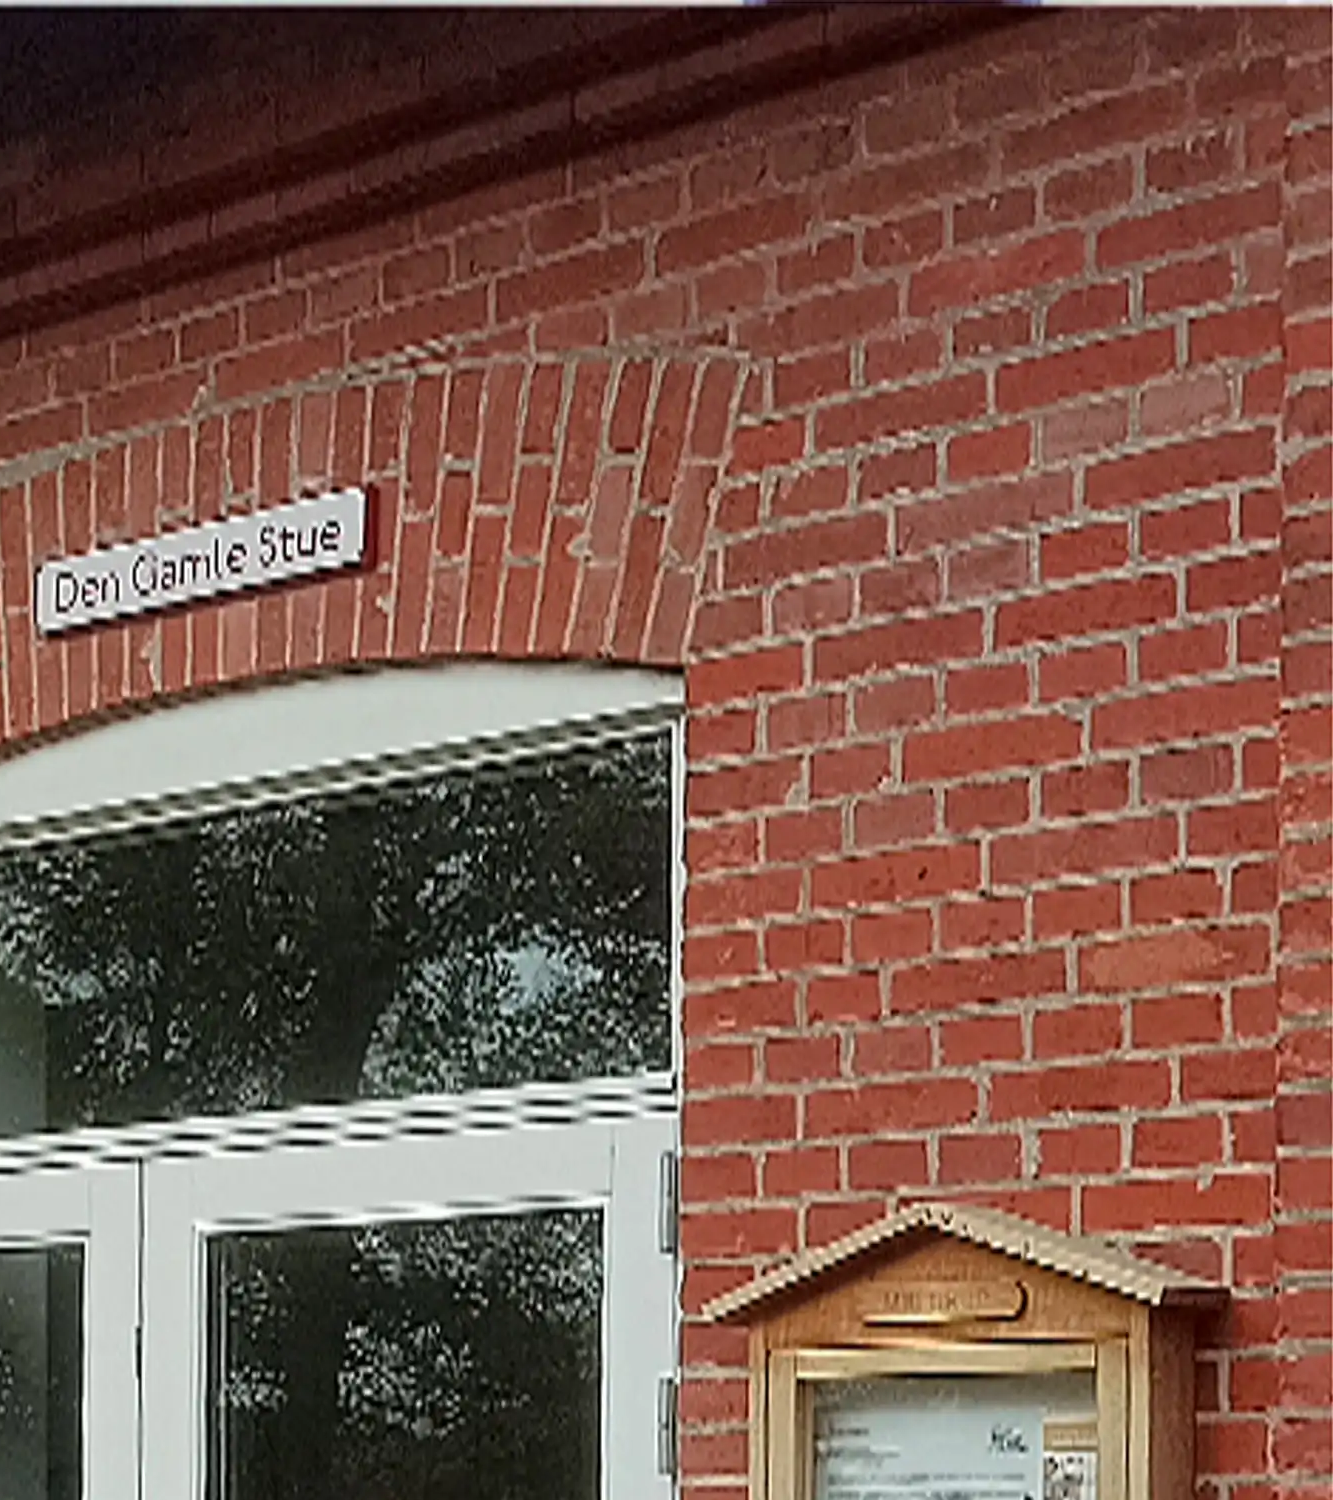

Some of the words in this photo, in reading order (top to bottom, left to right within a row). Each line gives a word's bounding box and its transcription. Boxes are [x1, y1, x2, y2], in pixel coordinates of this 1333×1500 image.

[54, 571, 121, 614] Den
[132, 538, 248, 597] Gamle
[259, 519, 342, 569] Stue
